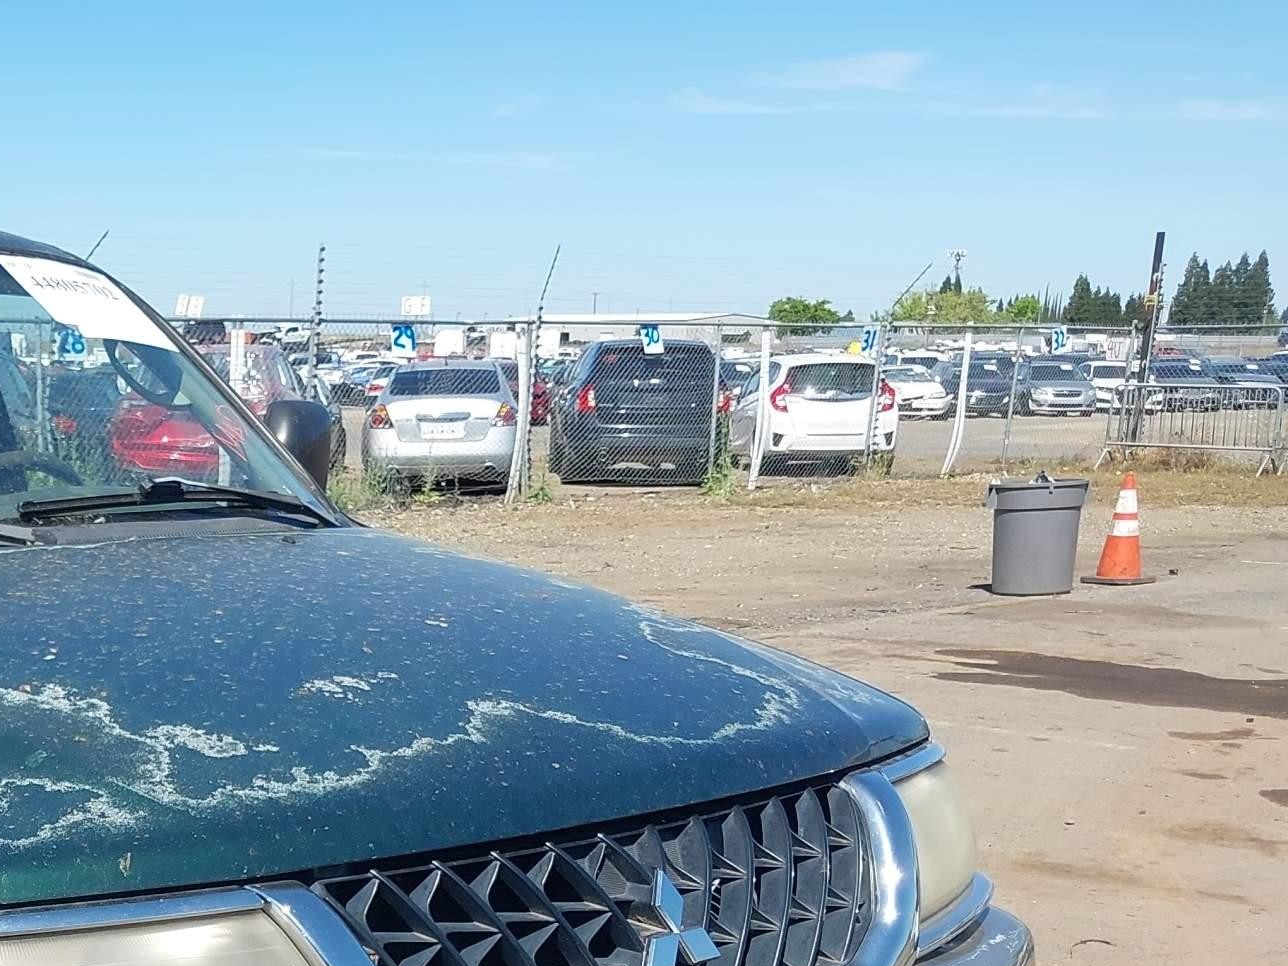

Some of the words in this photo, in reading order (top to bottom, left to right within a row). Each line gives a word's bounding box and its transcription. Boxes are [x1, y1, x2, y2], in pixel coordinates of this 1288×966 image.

[392, 325, 416, 351] 29
[640, 324, 660, 347] 30
[861, 329, 877, 352] 31
[1053, 329, 1067, 351] 32
